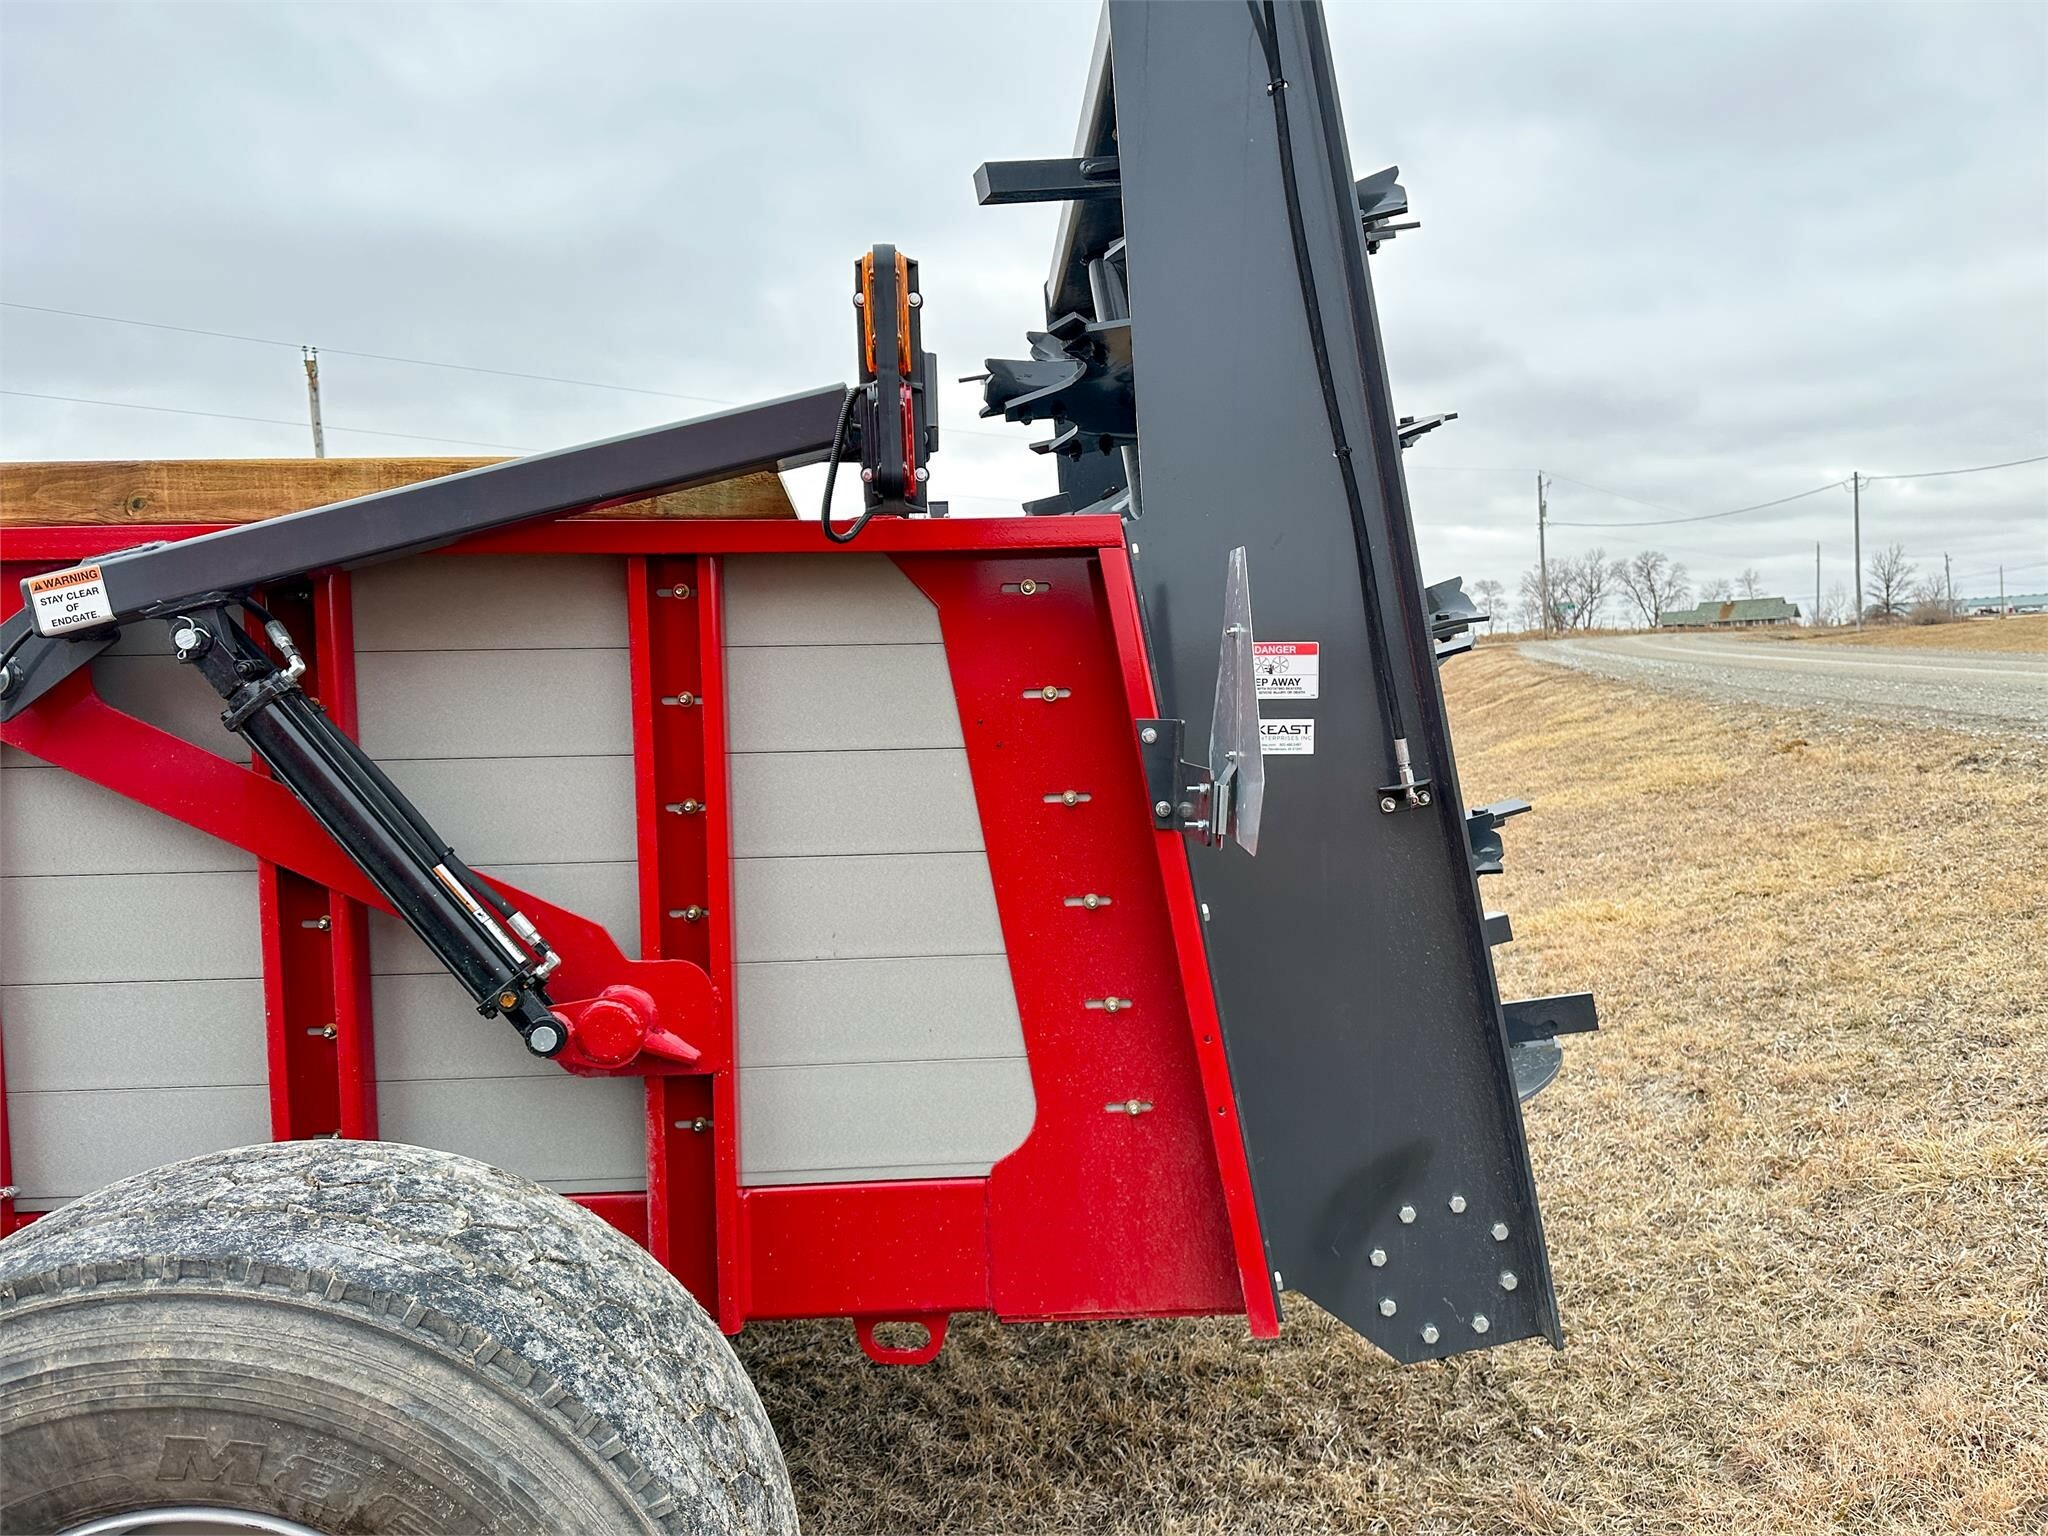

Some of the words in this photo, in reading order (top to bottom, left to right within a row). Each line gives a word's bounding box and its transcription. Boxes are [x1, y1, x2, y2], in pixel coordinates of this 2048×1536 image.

[43, 569, 98, 589] WARNING
[40, 594, 64, 606] STAY
[66, 586, 99, 601] CLEAR
[65, 603, 80, 612] OF
[51, 610, 101, 627] ENDGATE.
[1254, 645, 1297, 654] DANGER
[1256, 678, 1268, 687] EP
[1271, 678, 1301, 687] AWAY
